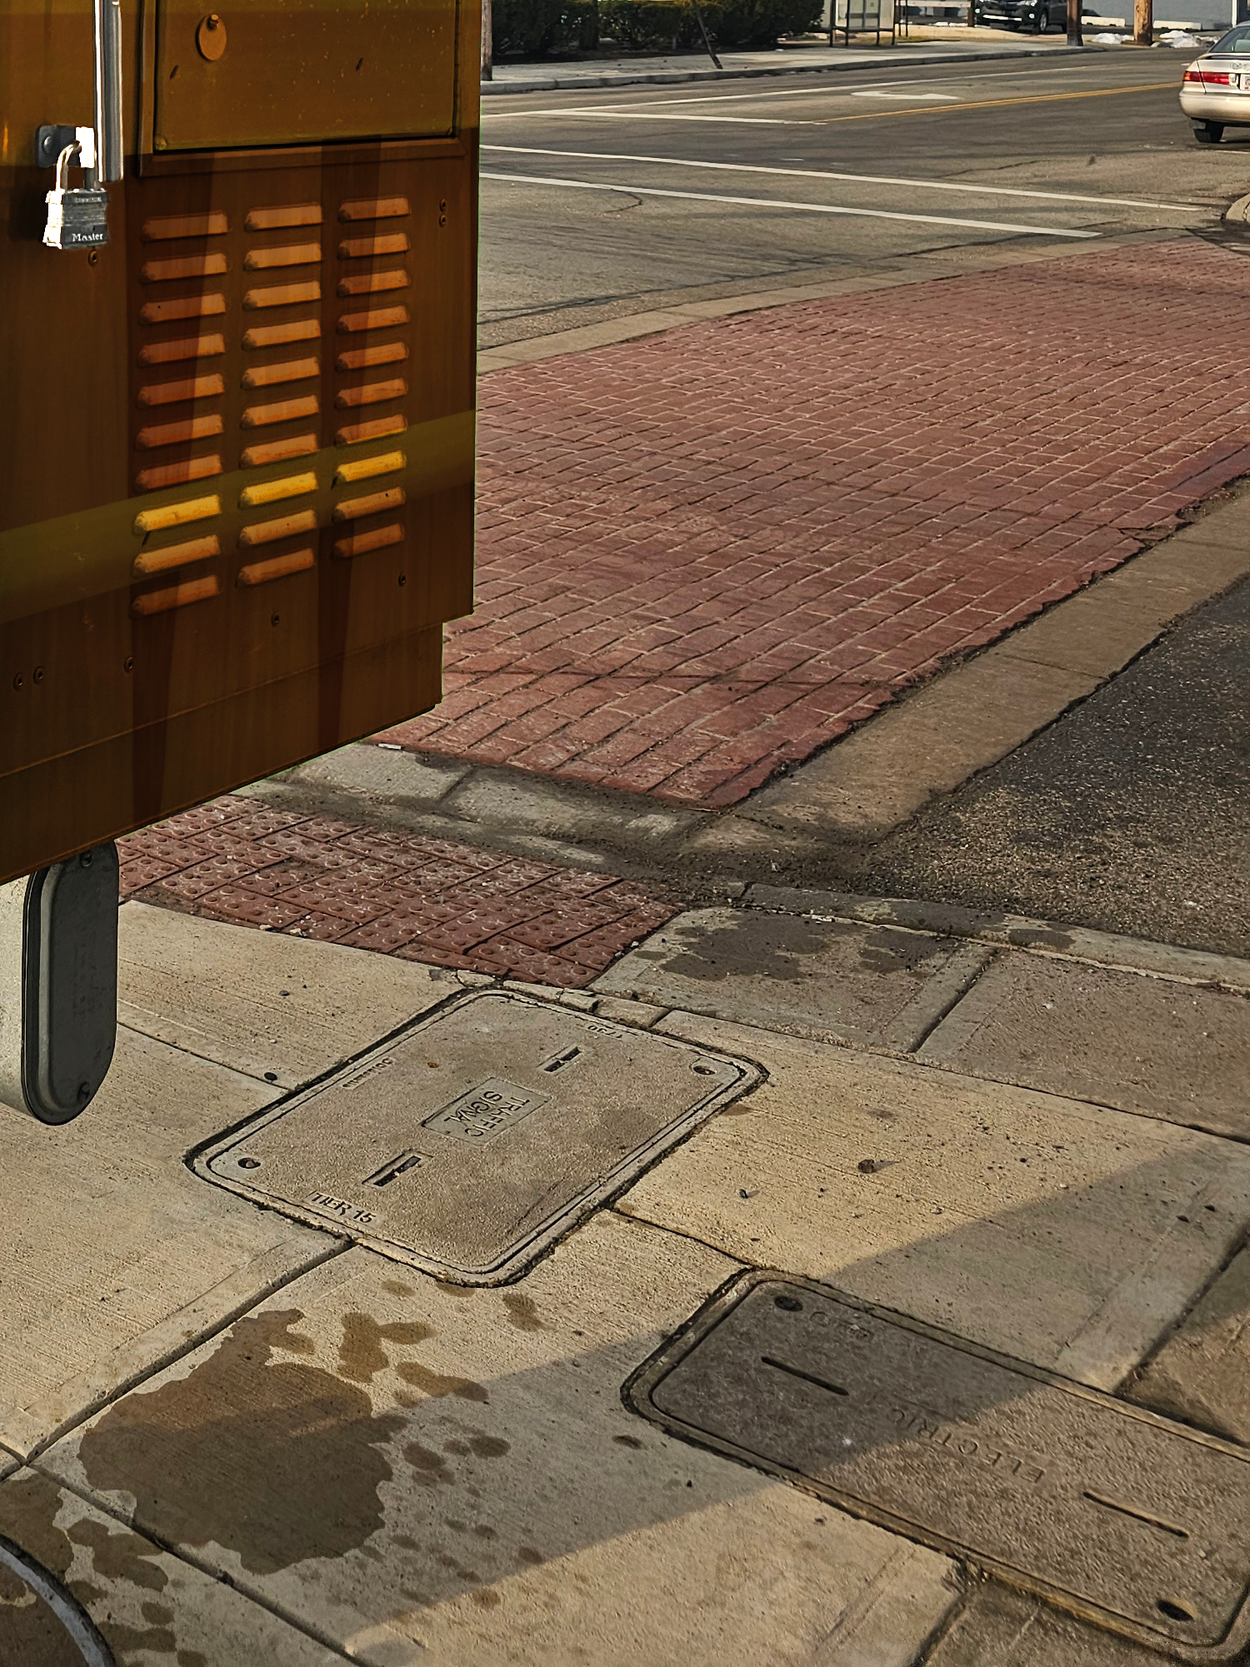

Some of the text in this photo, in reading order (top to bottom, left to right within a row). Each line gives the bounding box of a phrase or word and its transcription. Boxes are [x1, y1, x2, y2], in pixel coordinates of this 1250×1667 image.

[443, 1091, 503, 1123] SIGNAL
[464, 1097, 531, 1137] TRAFFIC
[311, 1192, 377, 1223] TIER 15
[886, 1407, 1047, 1484] ELECTRIC
